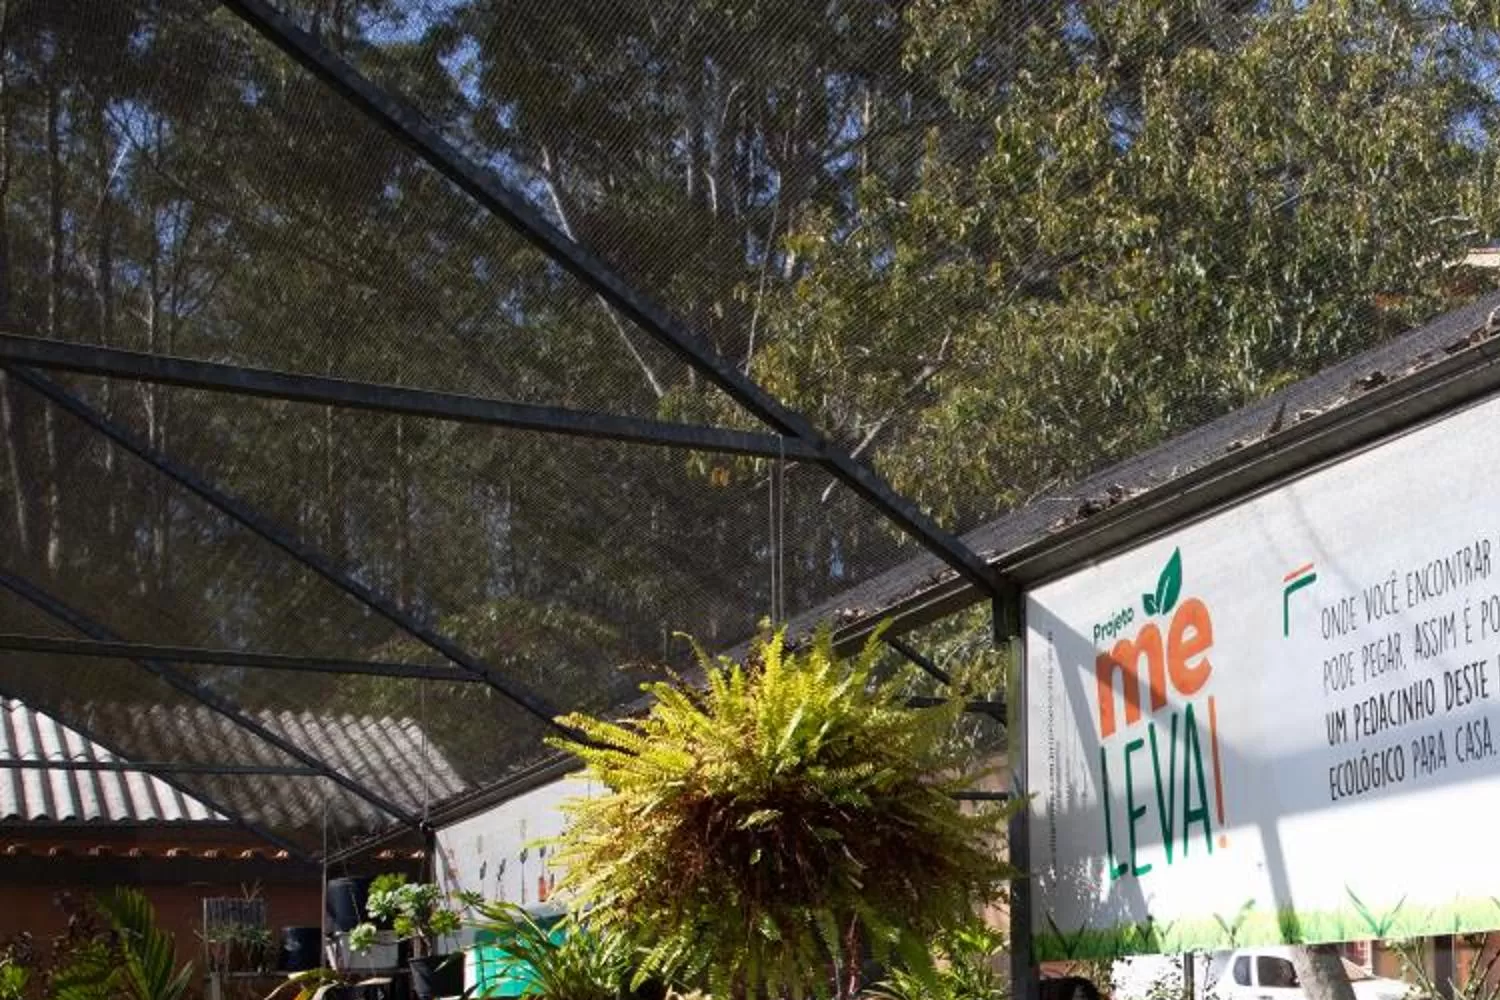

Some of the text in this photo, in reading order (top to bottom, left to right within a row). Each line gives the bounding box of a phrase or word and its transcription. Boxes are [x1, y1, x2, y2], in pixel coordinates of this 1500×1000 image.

[1093, 607, 1134, 645] Projeto
[1321, 597, 1357, 641] ONDE
[1363, 570, 1400, 624] VOCÊ
[1407, 539, 1492, 609] ENCONTRAR
[1095, 597, 1213, 739] me
[1323, 652, 1356, 697] PODE
[1414, 612, 1458, 656] ASSIM
[1463, 598, 1473, 644] É
[1326, 708, 1348, 746] UM
[1354, 678, 1436, 741] PEDACINHO
[1443, 660, 1490, 712] DESTE
[1101, 695, 1227, 882] LEVA!
[1329, 716, 1498, 801] ECOLÓGICO PARA CASA.
